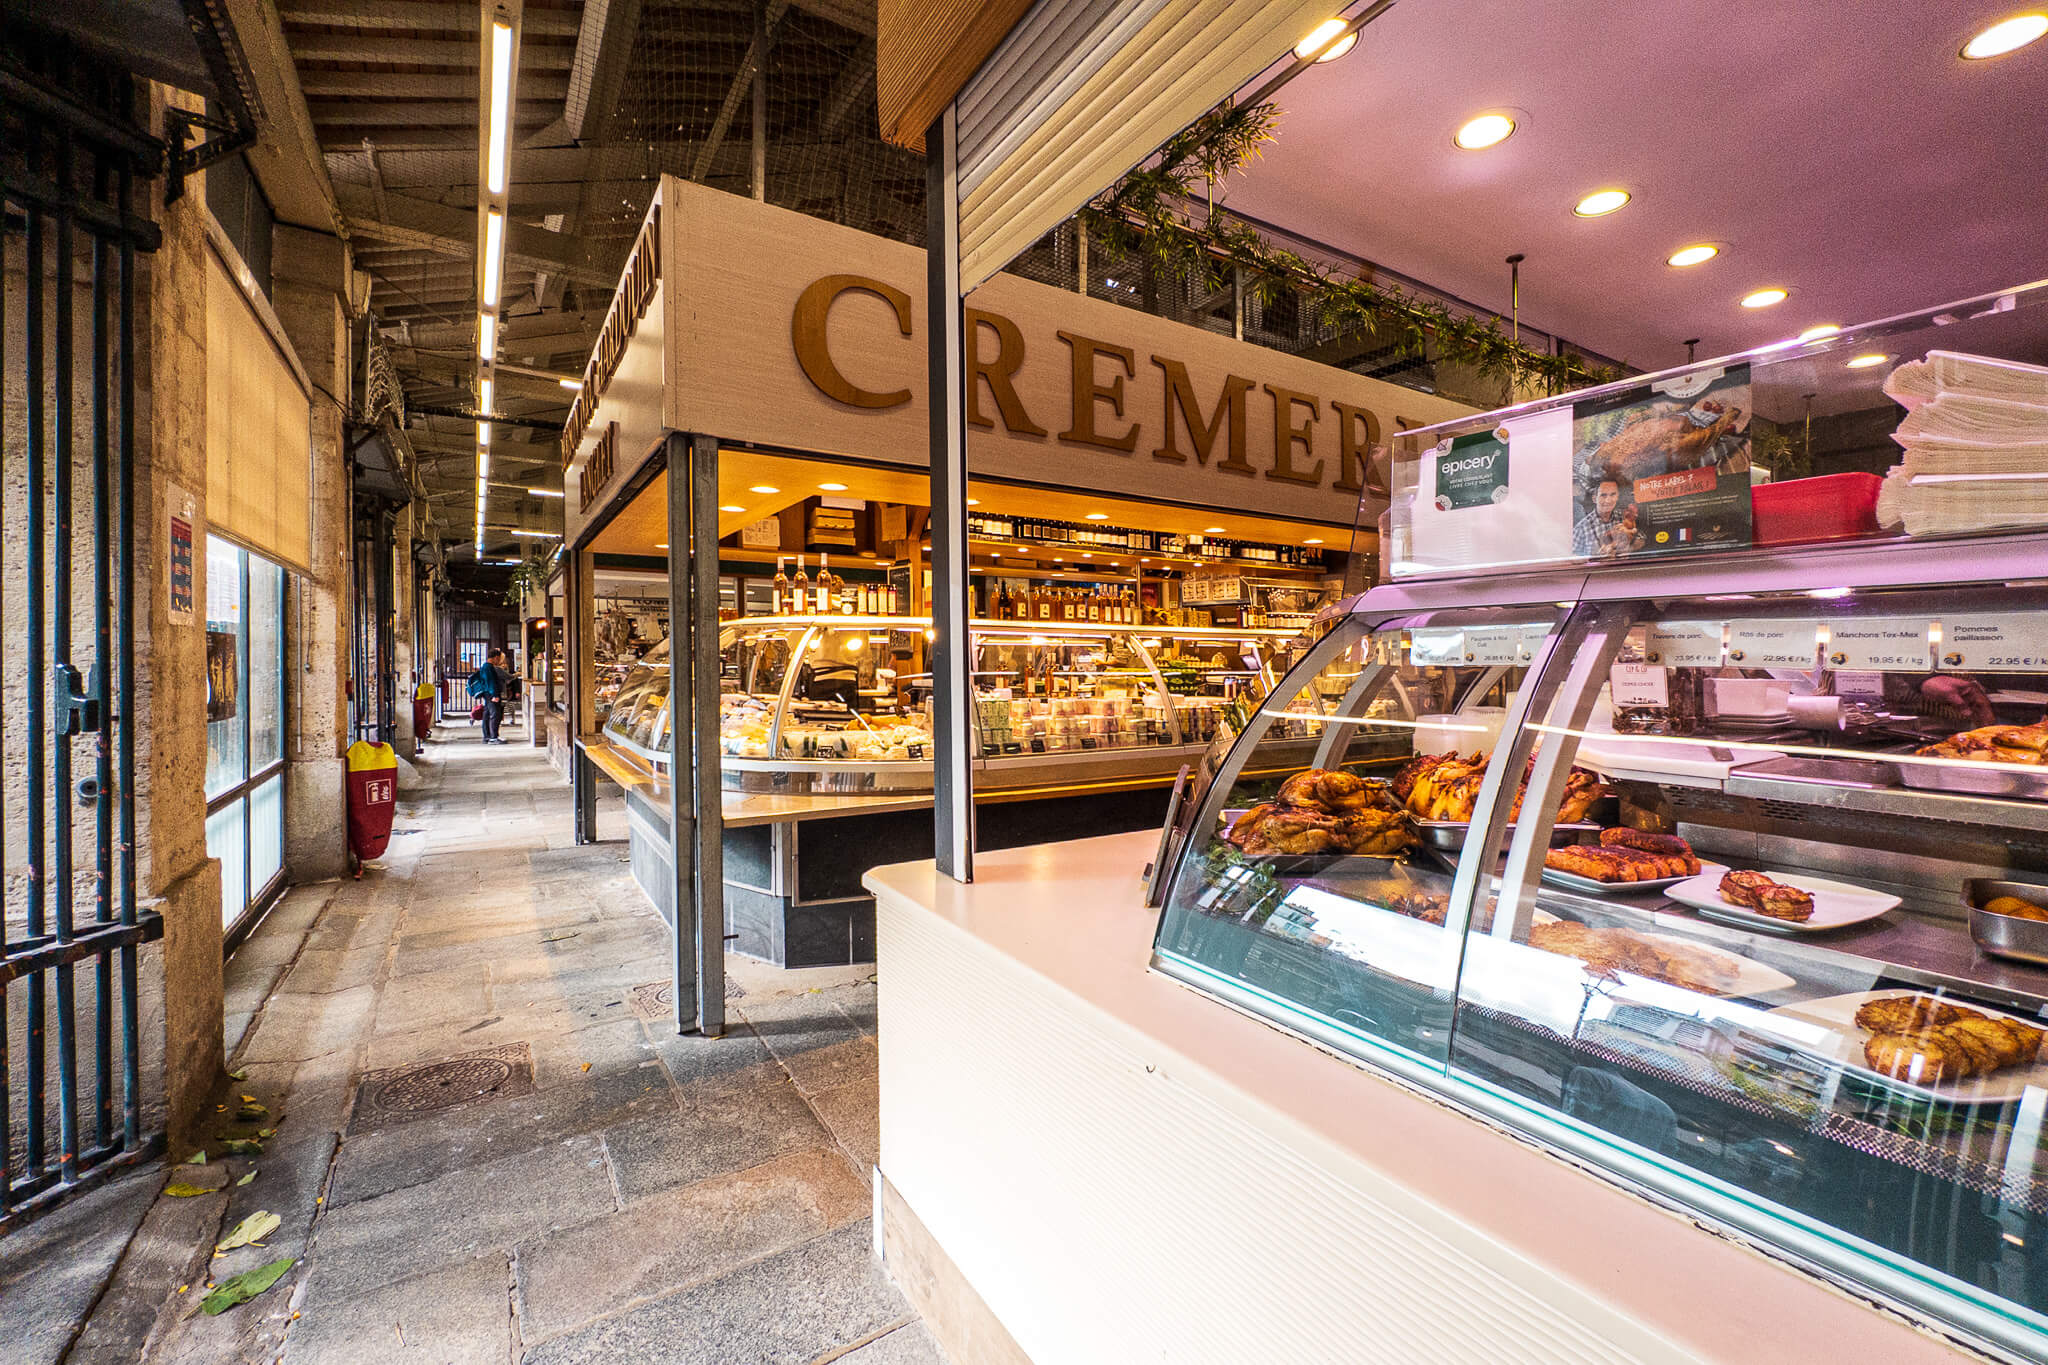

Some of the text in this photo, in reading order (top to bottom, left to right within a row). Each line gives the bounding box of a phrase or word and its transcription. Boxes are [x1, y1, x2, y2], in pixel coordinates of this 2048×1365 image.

[1441, 454, 1497, 476] epicery
[1639, 479, 1663, 491] NOTRE
[1953, 625, 1999, 633] Pommes
[1766, 631, 1785, 639] porc
[1835, 631, 1920, 639] Manchons Tex-Mex
[1953, 634, 2004, 642] paillasson
[1763, 654, 1786, 663] 22.95
[1787, 654, 1795, 663] €
[1896, 656, 1904, 664] €
[1911, 656, 1924, 666] kg
[1988, 657, 2021, 666] 22.95
[2022, 657, 2032, 666] €
